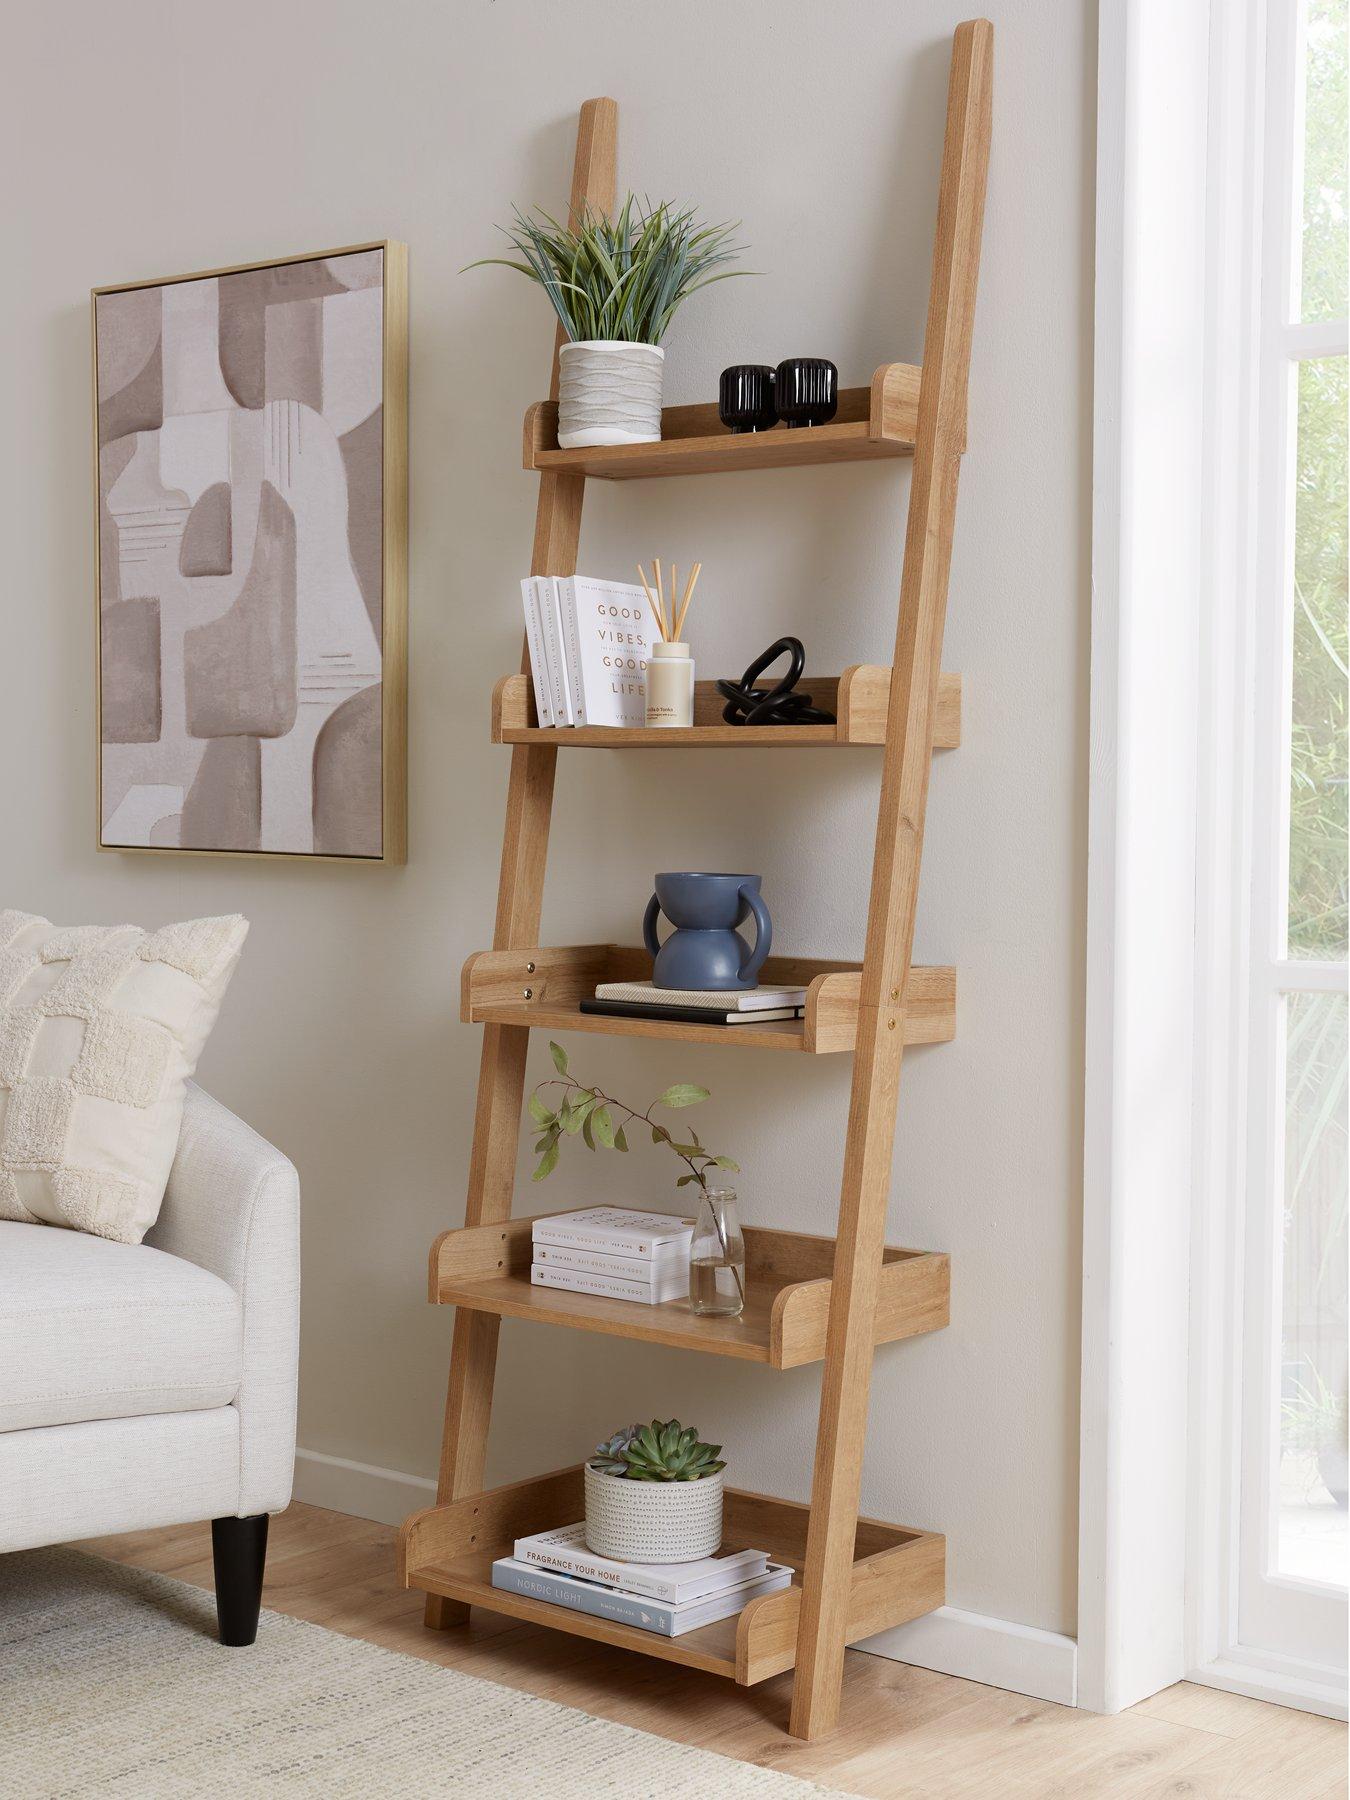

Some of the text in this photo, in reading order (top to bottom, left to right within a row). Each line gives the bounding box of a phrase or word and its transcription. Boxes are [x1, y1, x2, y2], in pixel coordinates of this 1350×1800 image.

[597, 604, 642, 620] GOOD
[598, 629, 647, 648] VIBES,
[602, 656, 647, 671] GOOD
[611, 682, 645, 696] LIFE
[526, 1551, 573, 1570] FRAGRANCE
[574, 1564, 596, 1576] YOUR
[598, 1569, 621, 1583] HOME
[517, 1578, 552, 1596] NORDIC
[555, 1588, 583, 1604] LIGHT
